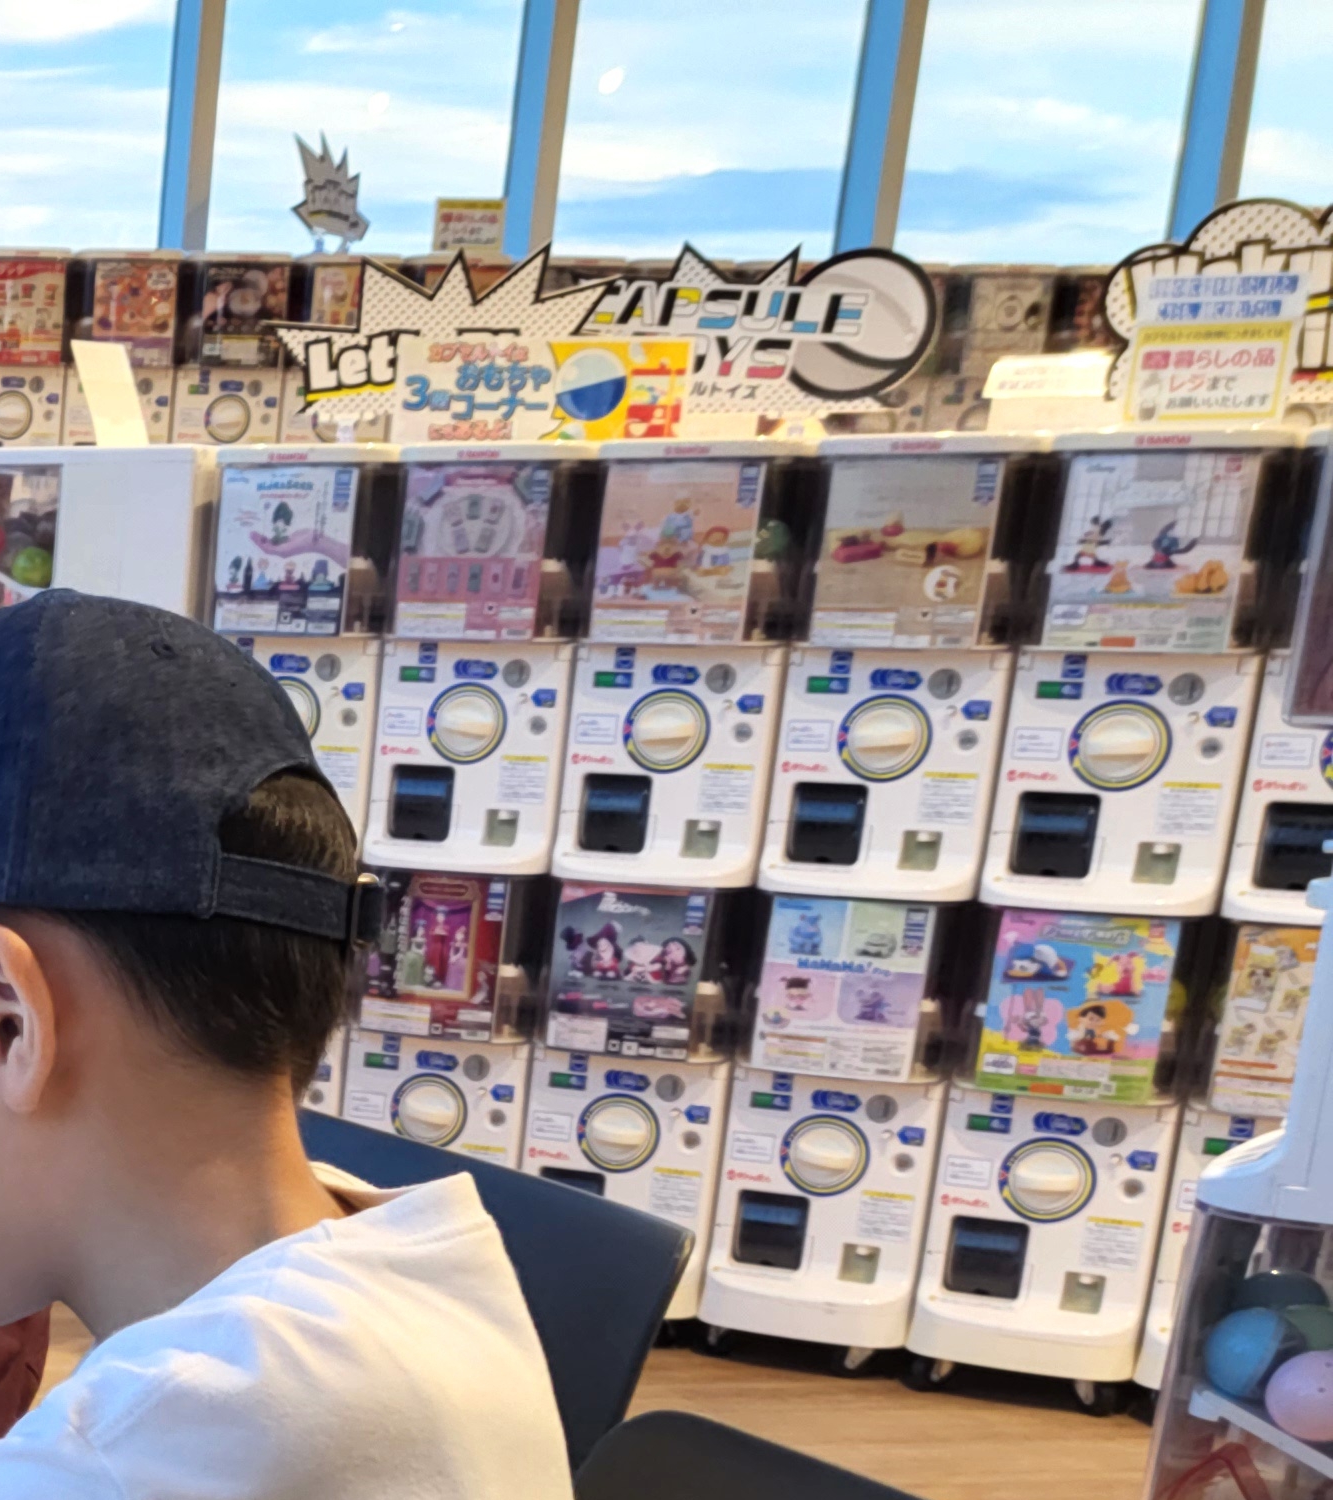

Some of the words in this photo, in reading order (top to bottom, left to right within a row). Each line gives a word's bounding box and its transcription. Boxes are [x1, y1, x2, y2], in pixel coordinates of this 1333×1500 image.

[455, 361, 552, 392] おもちゃ
[1167, 372, 1238, 393] レジまで
